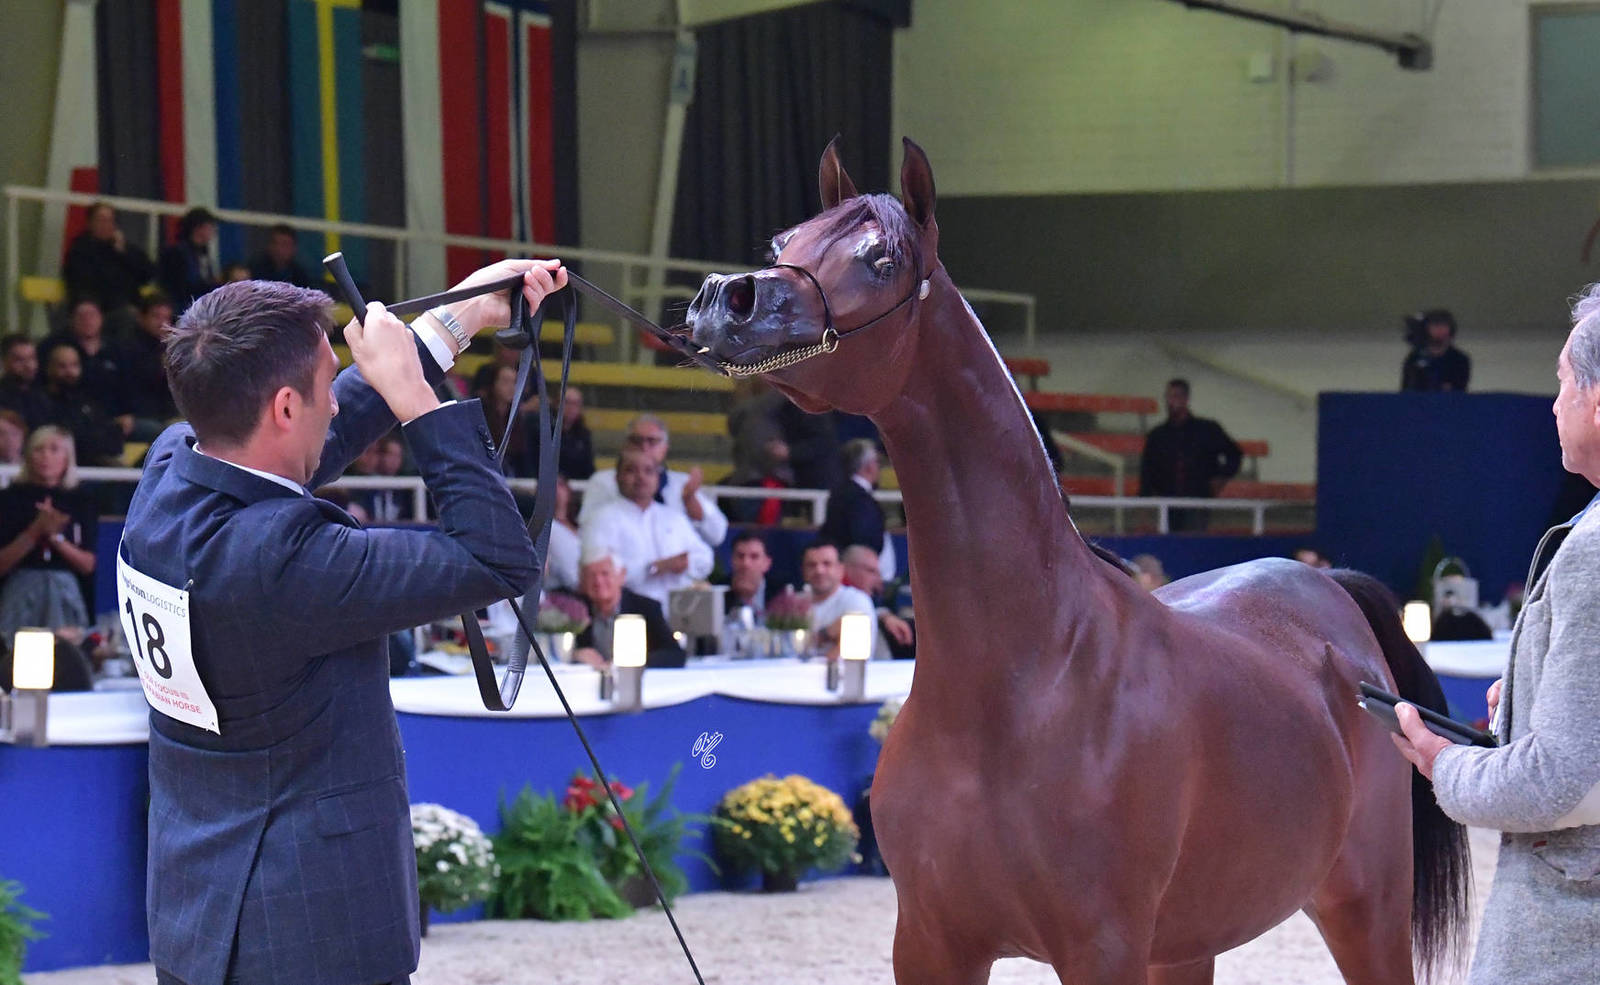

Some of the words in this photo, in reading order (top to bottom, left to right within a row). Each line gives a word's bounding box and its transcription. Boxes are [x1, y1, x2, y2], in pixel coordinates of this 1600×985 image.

[125, 596, 173, 680] 18
[155, 681, 179, 697] FOCUS
[172, 699, 202, 714] HORSE
